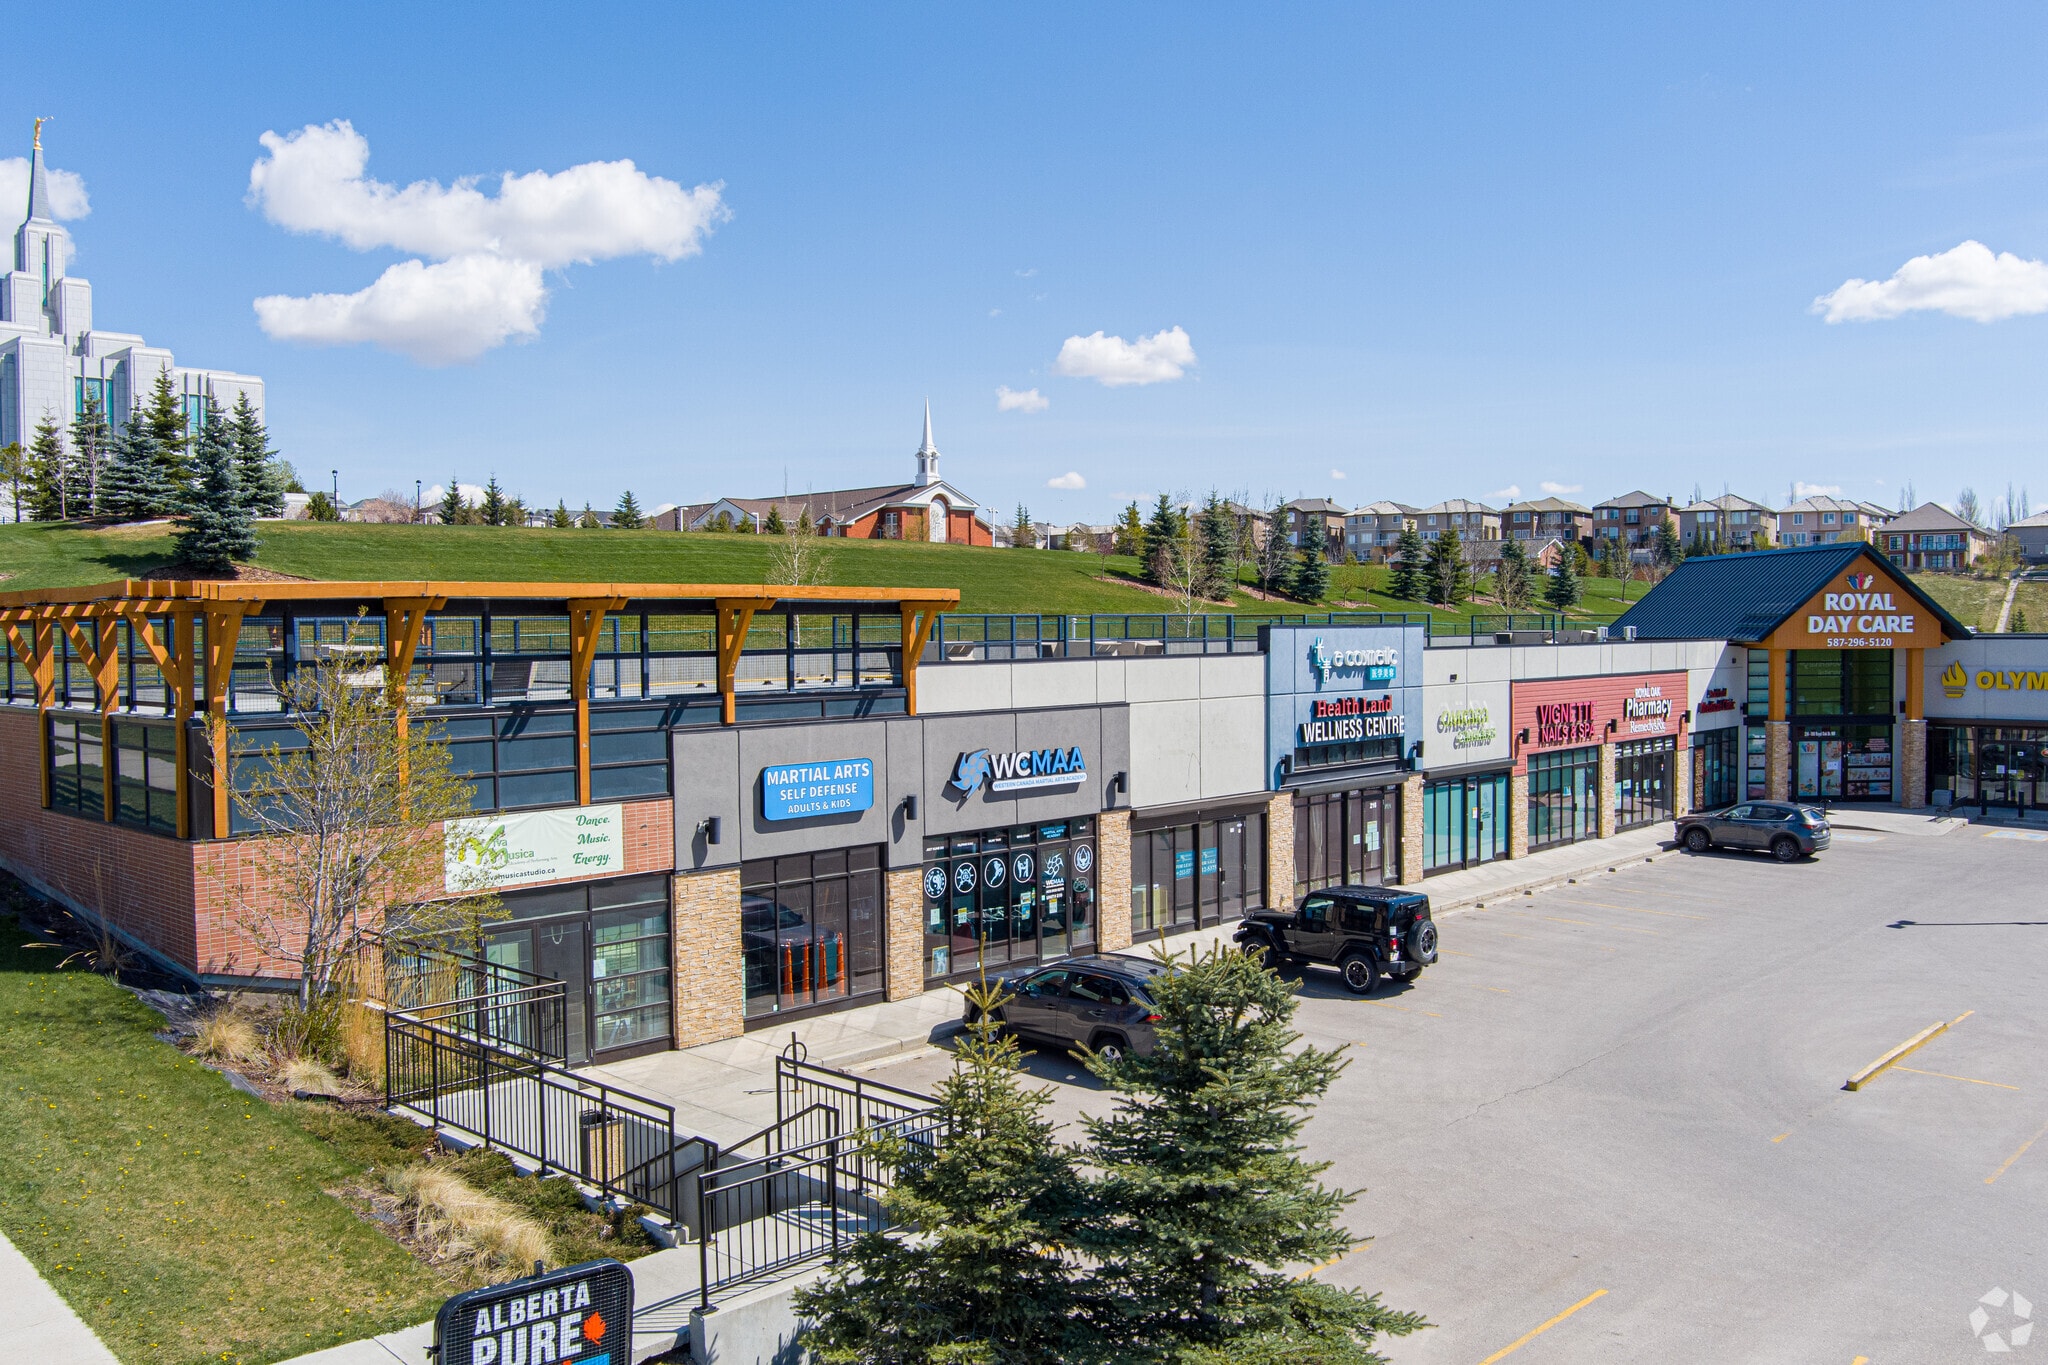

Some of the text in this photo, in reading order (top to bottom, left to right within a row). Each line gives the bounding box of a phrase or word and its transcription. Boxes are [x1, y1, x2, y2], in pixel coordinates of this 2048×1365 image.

[1824, 593, 1897, 611] ROYAL
[1808, 615, 1914, 633] DAY CARE
[1827, 638, 1892, 647] 587-296-5120
[1975, 671, 2048, 690] OLYM
[1634, 686, 1662, 698] ROYAL OAK
[1316, 694, 1393, 718] Health Land
[1540, 701, 1597, 727] VIGNETTE
[1627, 697, 1672, 718] Pharmacy
[1304, 715, 1405, 743] WELLNESS CENTRE
[1542, 723, 1595, 742] NAILS & SPA
[991, 746, 1086, 779] WCMAA
[767, 763, 870, 786] MARTIAL ARTS
[780, 783, 857, 801] SELF DEFENSE
[788, 798, 851, 814] ADULTS & KIDS
[575, 814, 610, 826] Dance.
[577, 833, 610, 845] Music.
[572, 852, 611, 866] Energy.
[474, 1280, 591, 1336] ALBERTA
[472, 1311, 583, 1365] PURE
